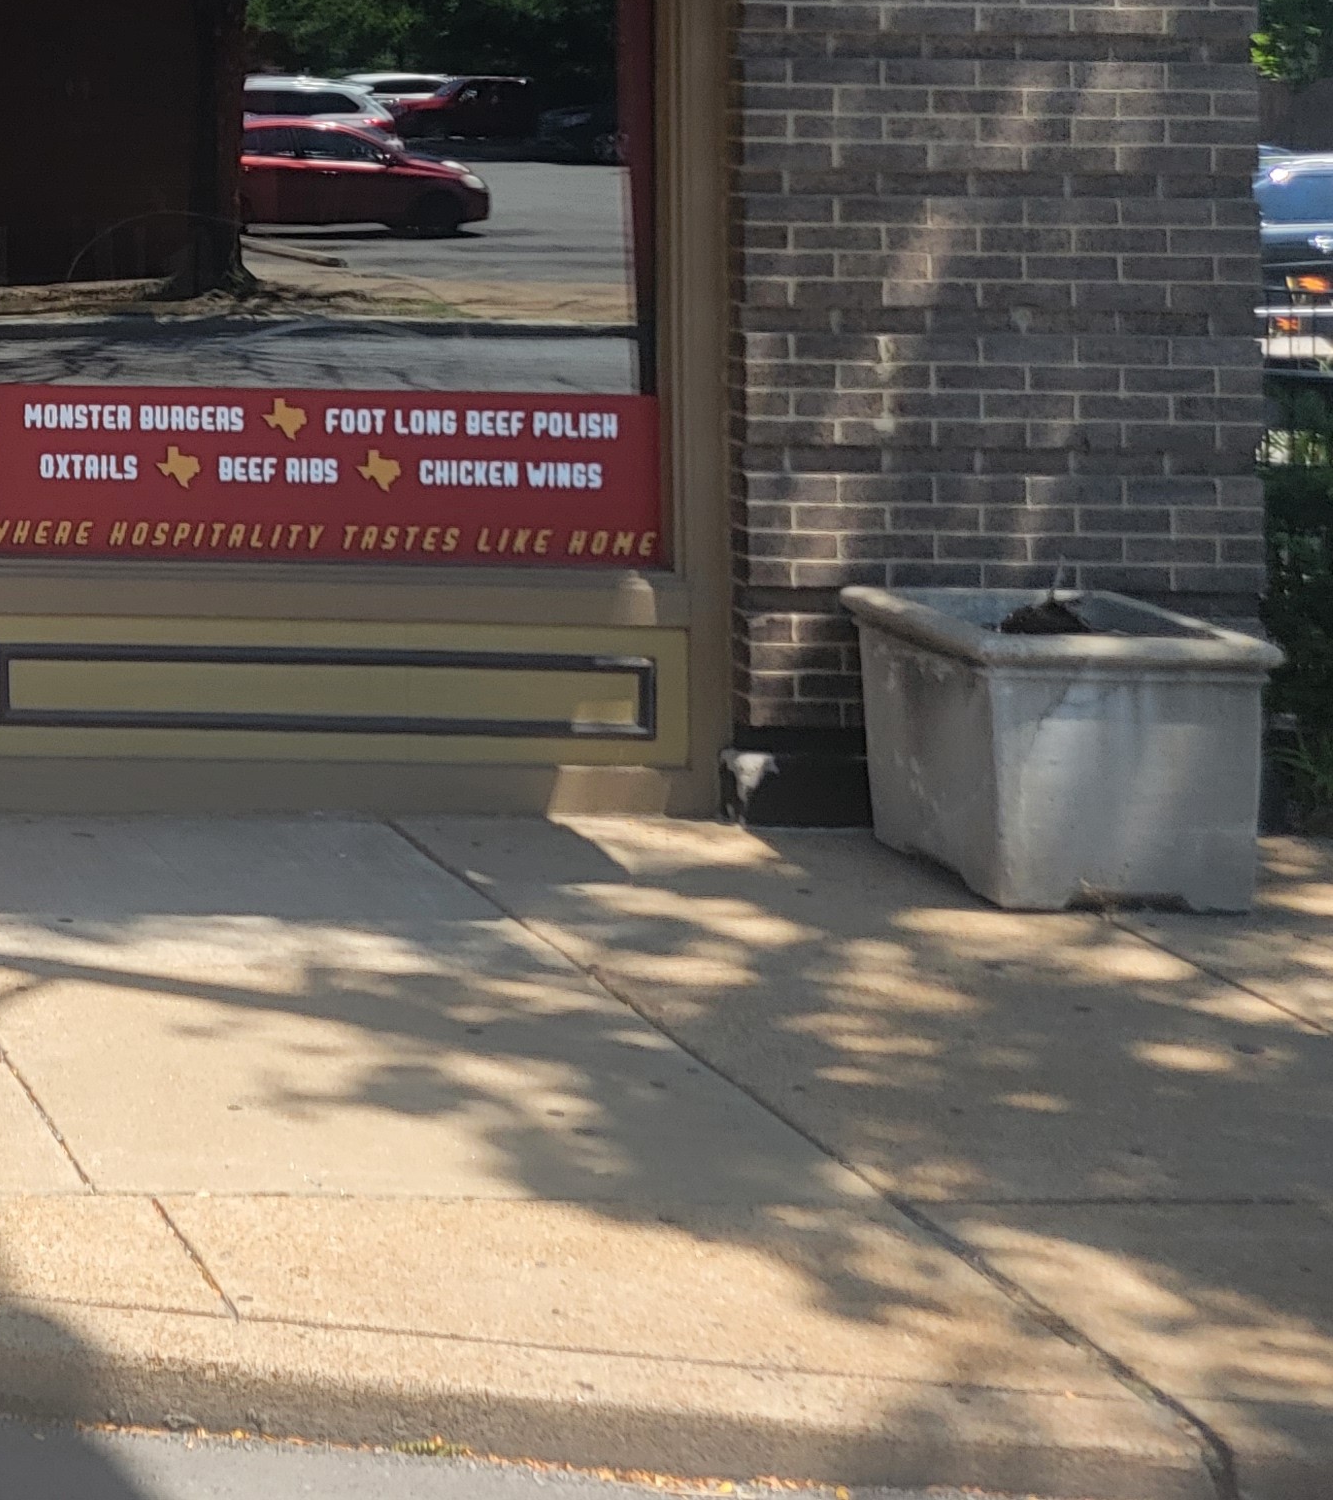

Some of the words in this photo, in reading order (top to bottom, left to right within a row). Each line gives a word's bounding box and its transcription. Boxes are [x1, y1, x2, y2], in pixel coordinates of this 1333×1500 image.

[25, 404, 131, 429] MONSTER
[140, 406, 243, 431] BURGERS
[326, 409, 386, 434] FOOT
[395, 410, 457, 434] LONG
[466, 411, 524, 436] BEEF
[533, 412, 617, 438] POLISH
[40, 454, 137, 479] OXTAILS
[219, 457, 277, 482] BEEF
[286, 458, 337, 482] RIBS
[420, 460, 518, 486] CHICKEN
[527, 462, 602, 488] WINGS
[110, 522, 323, 548] HOSPITALITY
[344, 526, 459, 551] TASTES
[478, 528, 552, 553] LIKE
[569, 531, 656, 555] HOME
